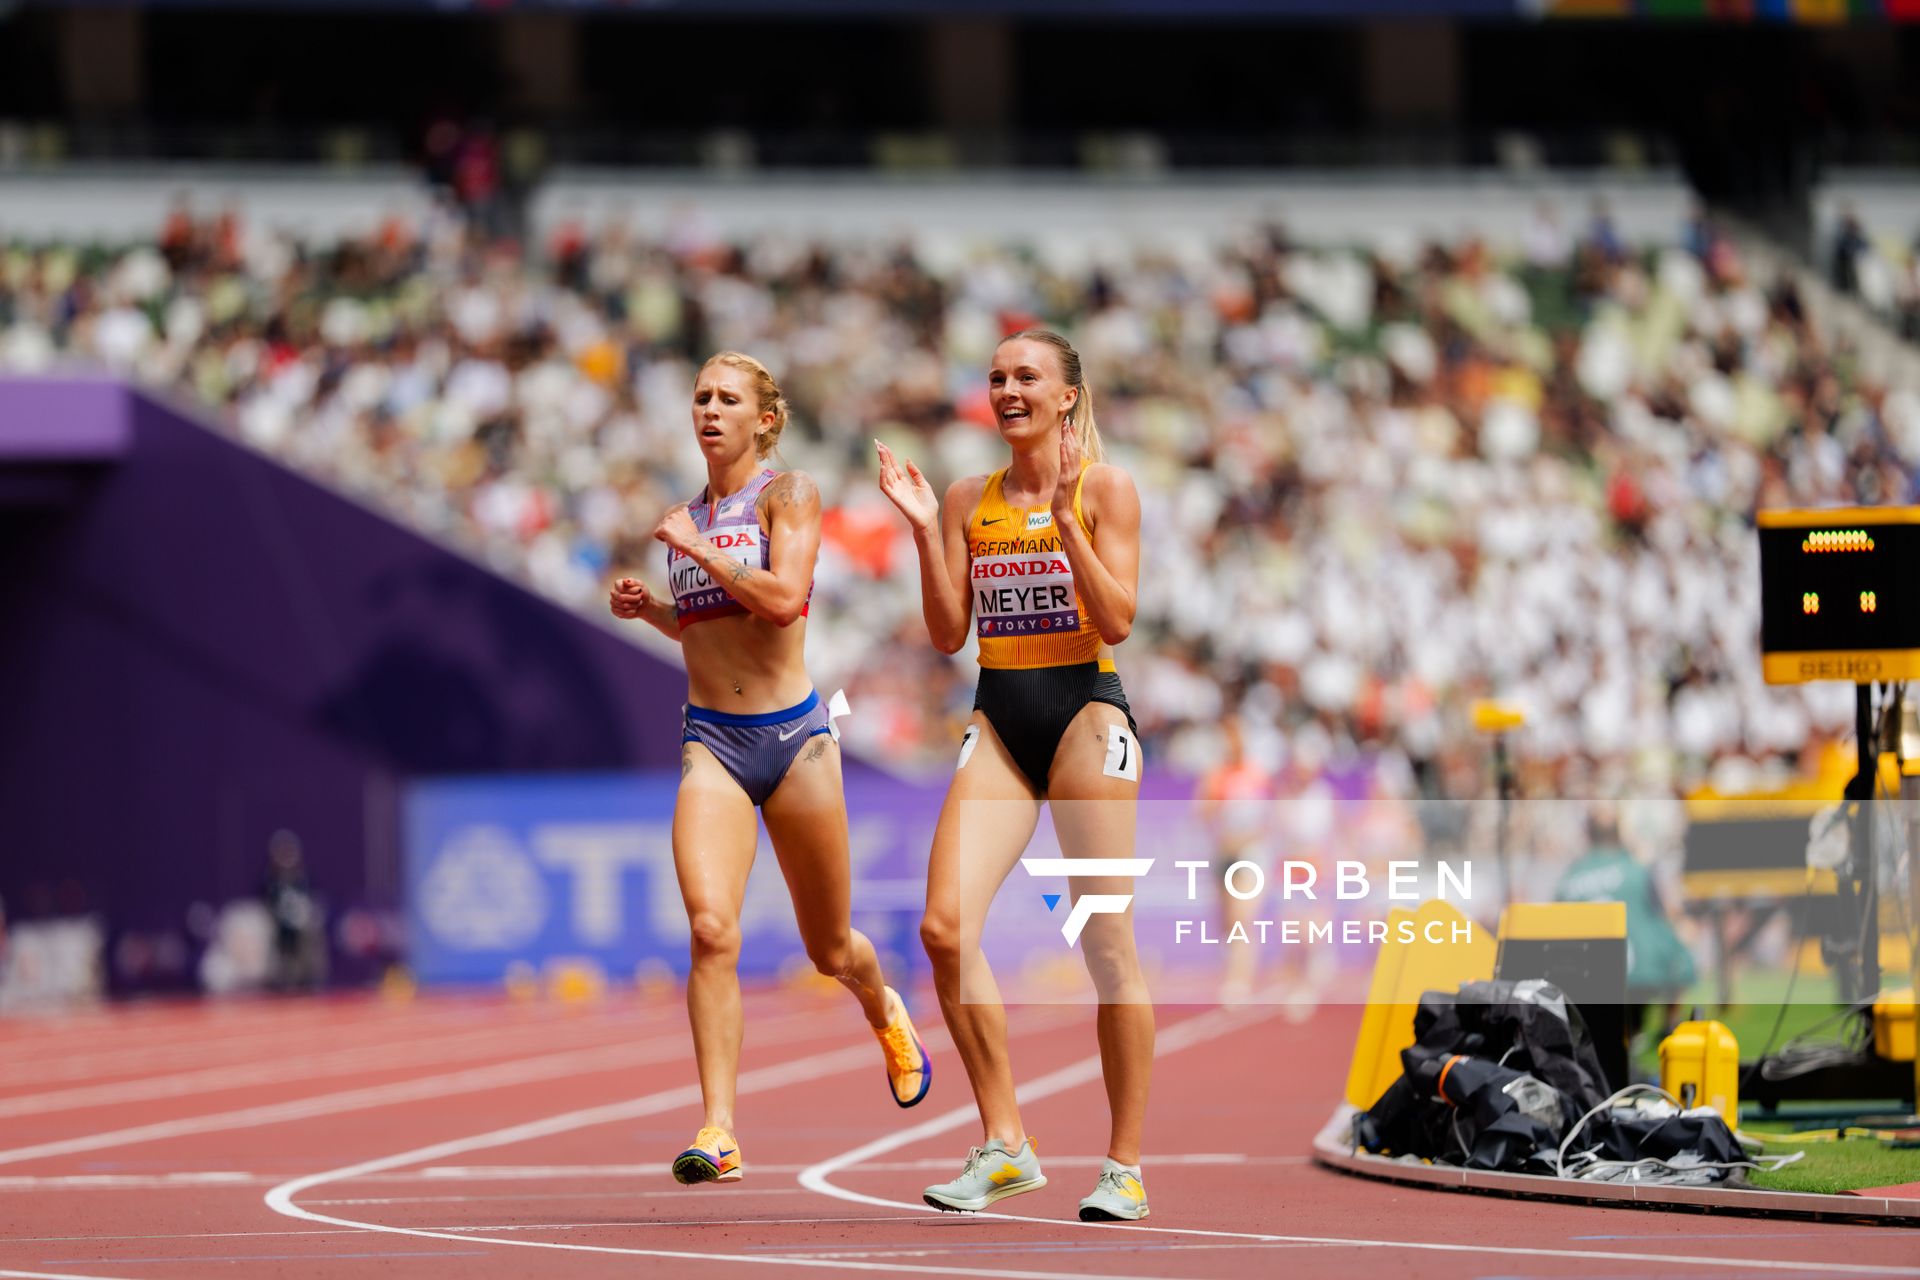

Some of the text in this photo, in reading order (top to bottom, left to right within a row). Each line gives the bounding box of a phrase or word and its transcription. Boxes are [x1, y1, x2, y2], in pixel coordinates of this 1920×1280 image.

[1028, 514, 1052, 526] WGV
[973, 559, 1070, 579] HONDA
[980, 585, 1070, 614] MEYER
[1118, 735, 1128, 771] 7
